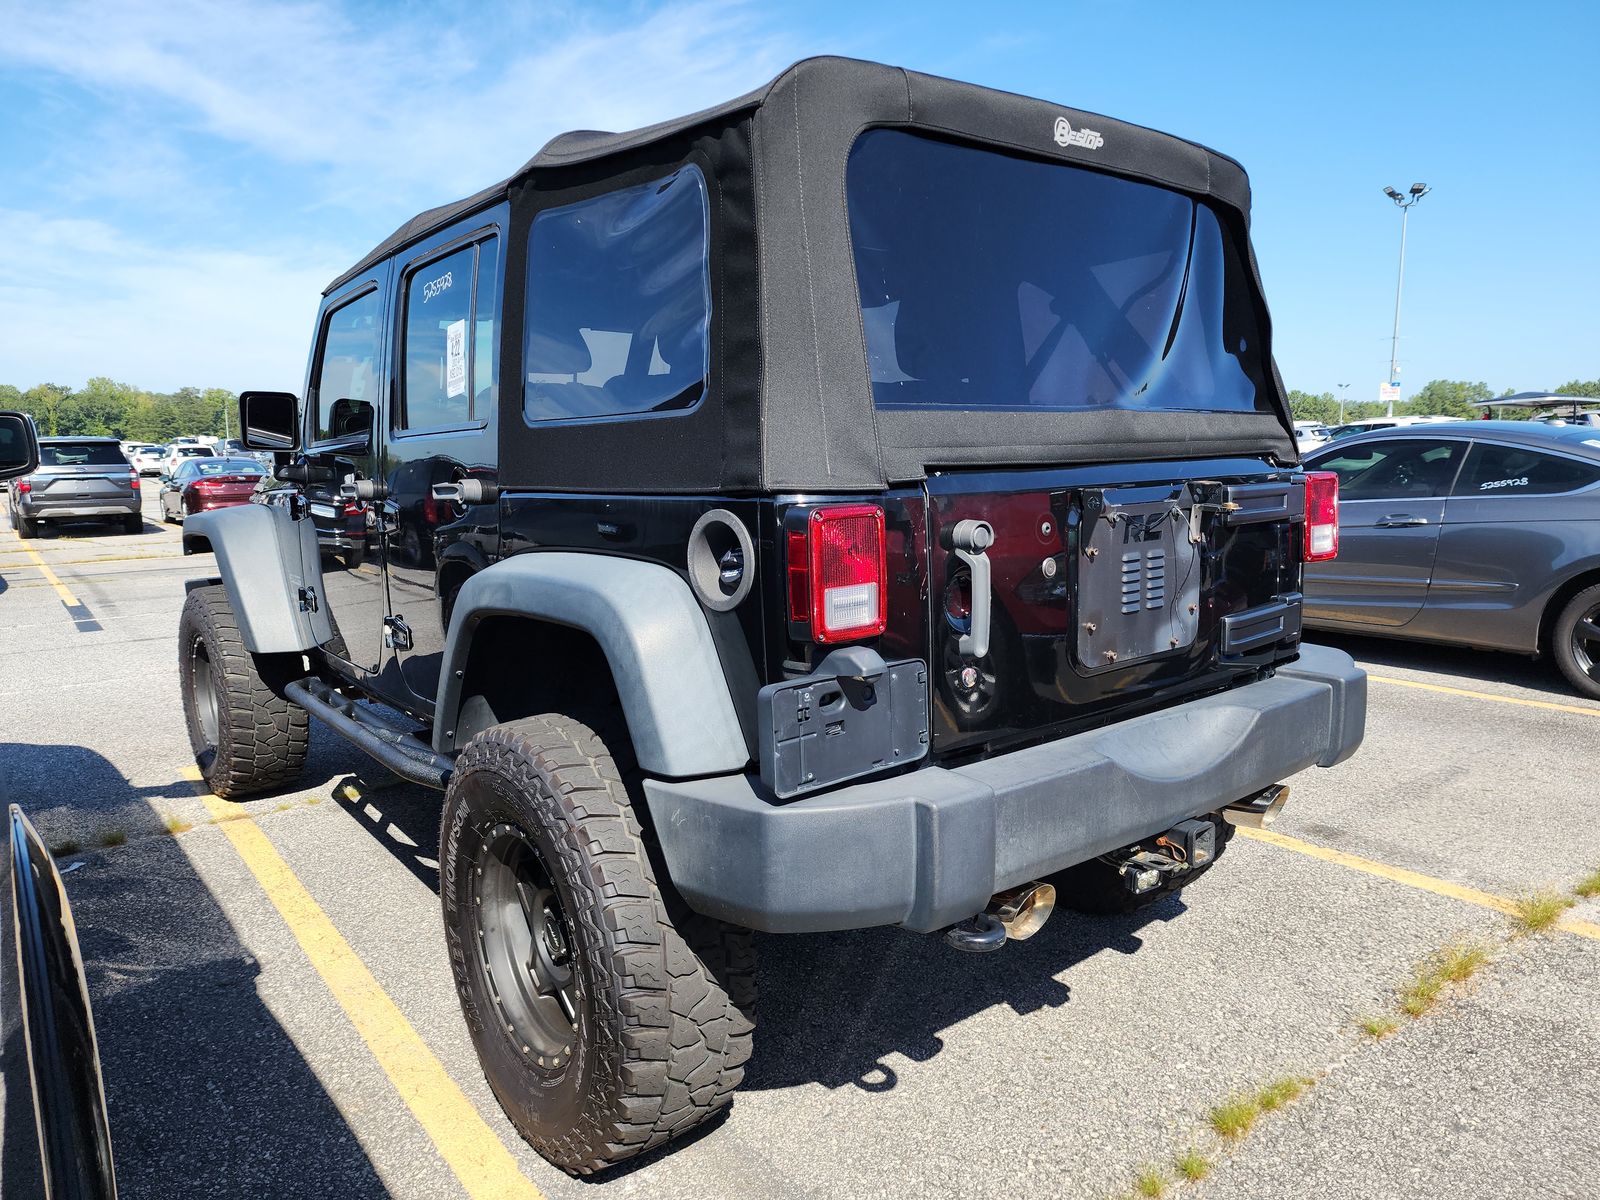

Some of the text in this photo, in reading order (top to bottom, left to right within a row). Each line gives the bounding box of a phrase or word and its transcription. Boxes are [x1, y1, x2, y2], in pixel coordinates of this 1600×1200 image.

[423, 271, 453, 304] 5255928
[1480, 477, 1529, 490] 5255928
[445, 797, 471, 913] THOMPSON
